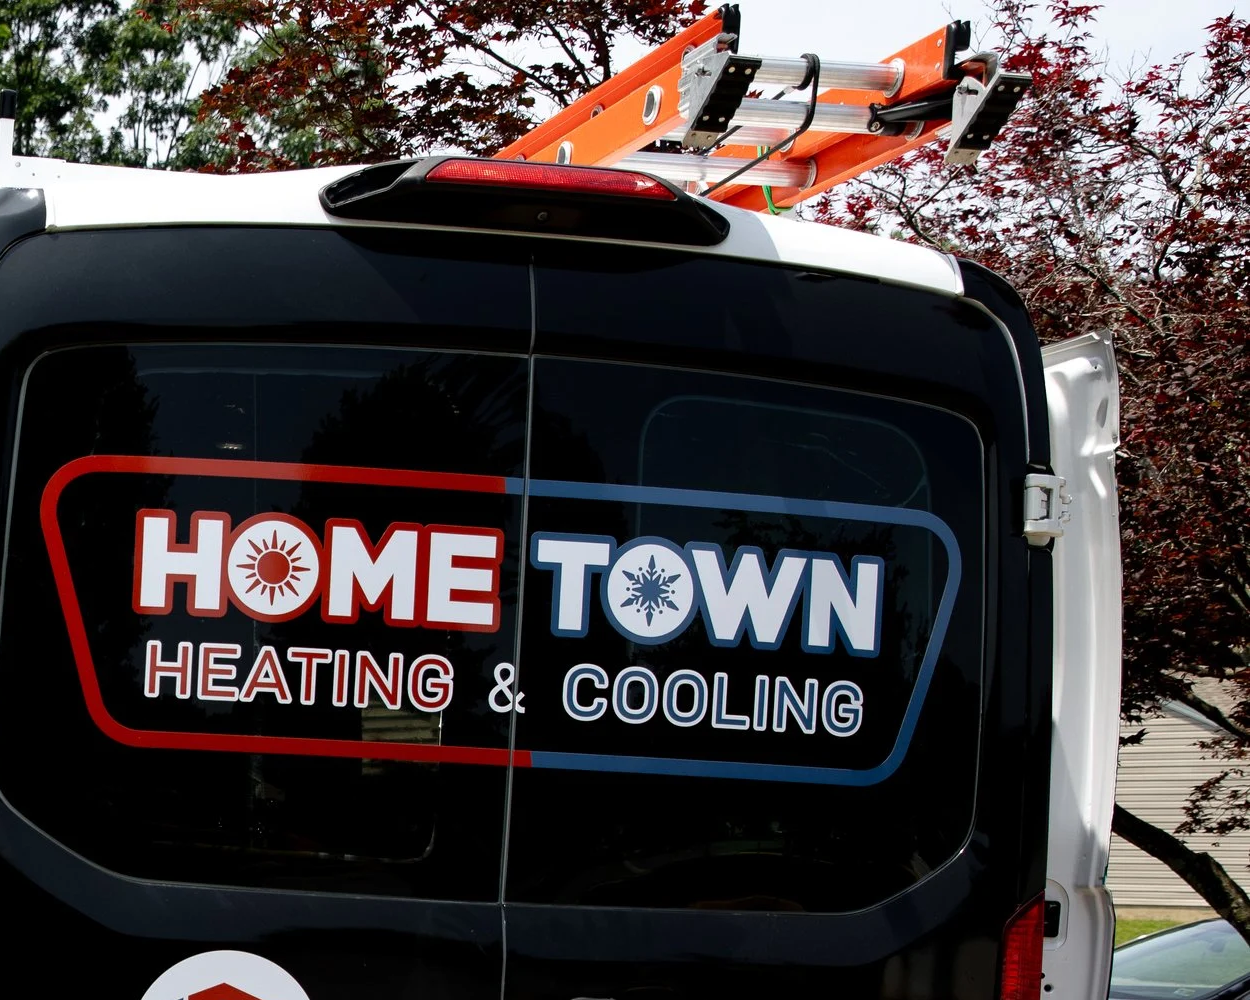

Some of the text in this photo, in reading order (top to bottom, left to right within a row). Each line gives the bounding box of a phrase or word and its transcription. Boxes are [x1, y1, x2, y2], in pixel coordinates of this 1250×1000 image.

[138, 511, 882, 655] HOME TOWN
[144, 639, 864, 736] HEATING & COOLING
